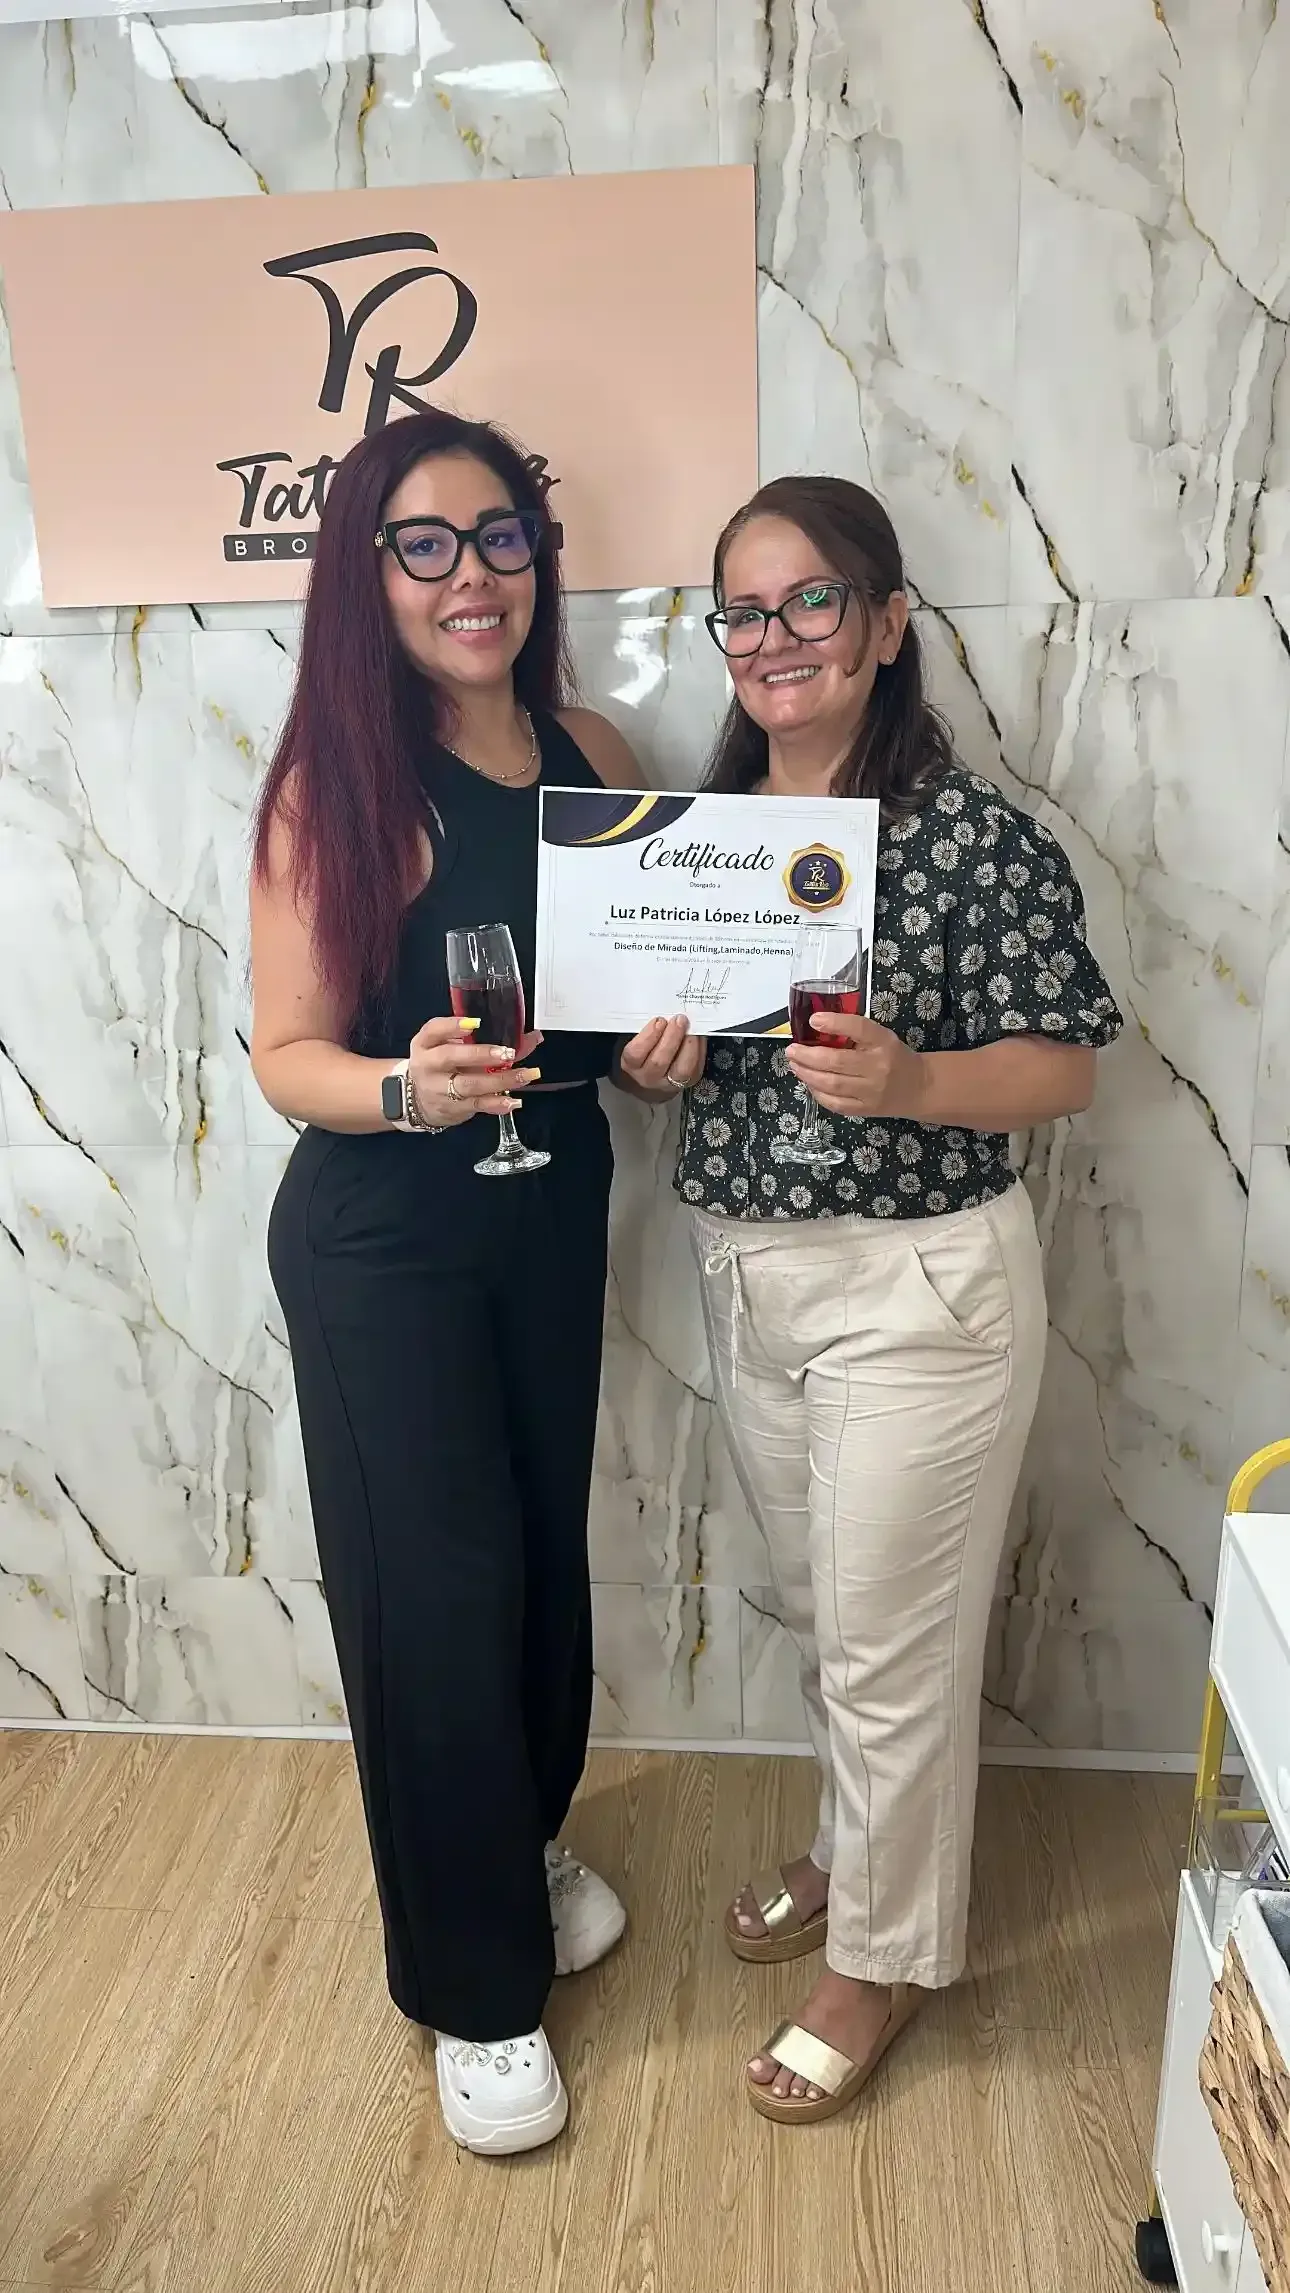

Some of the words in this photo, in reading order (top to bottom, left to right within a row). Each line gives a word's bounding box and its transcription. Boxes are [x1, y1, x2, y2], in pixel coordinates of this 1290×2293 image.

[639, 837, 775, 878] Certificado
[610, 905, 636, 920] Luz
[641, 906, 700, 922] Patricia
[705, 907, 750, 924] López
[755, 909, 801, 925] López
[614, 941, 643, 952] Diseño
[645, 942, 656, 952] de
[657, 943, 687, 953] Mirada
[689, 944, 794, 957] (Lifting,Laminado,Henna)
